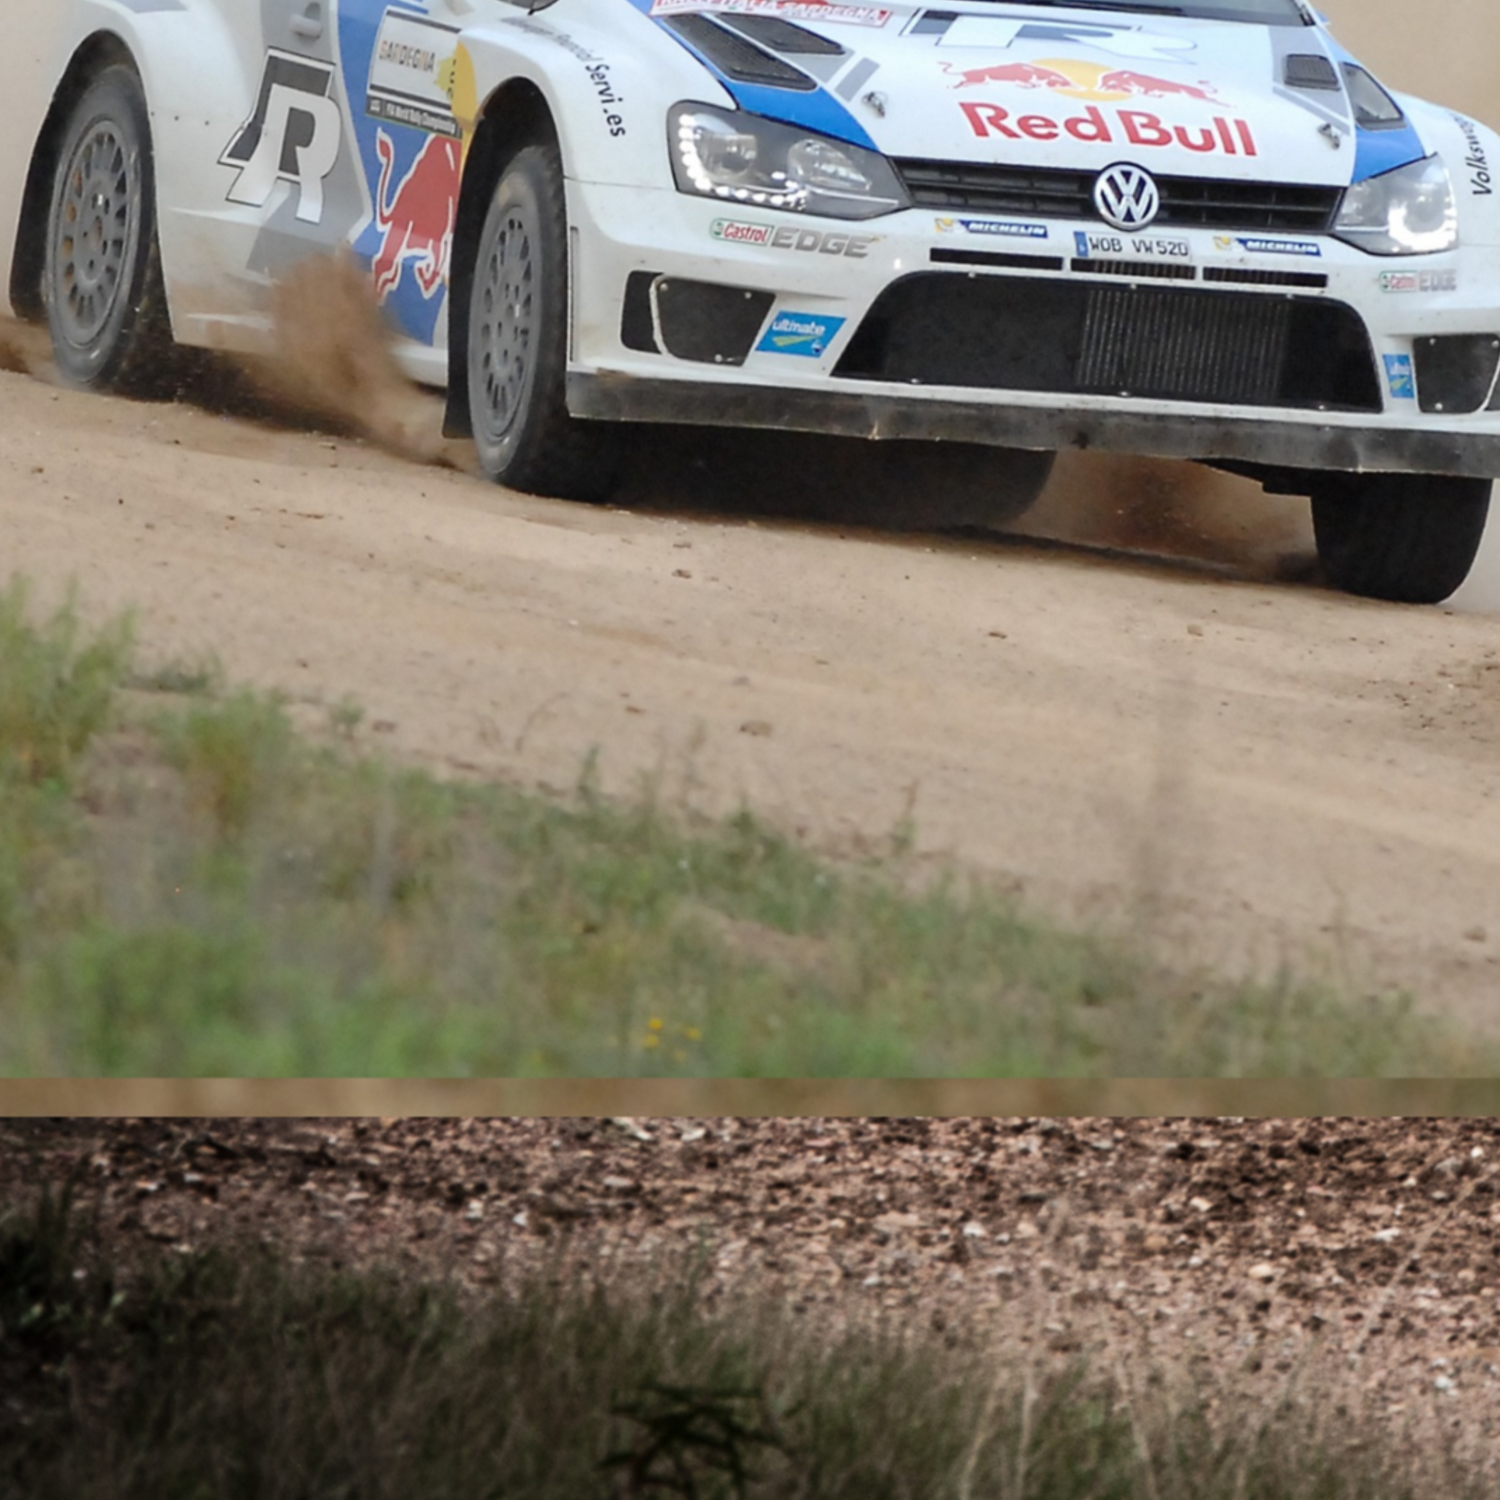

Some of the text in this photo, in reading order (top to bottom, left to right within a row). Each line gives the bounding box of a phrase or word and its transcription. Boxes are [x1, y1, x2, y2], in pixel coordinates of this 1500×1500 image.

[958, 101, 1258, 157] Red Bull
[968, 221, 1046, 236] MICHELIN
[723, 223, 873, 259] Castrol EDGE
[1088, 236, 1123, 253] WOB
[1246, 240, 1319, 254] MICHELIN
[771, 318, 827, 337] ultimate
